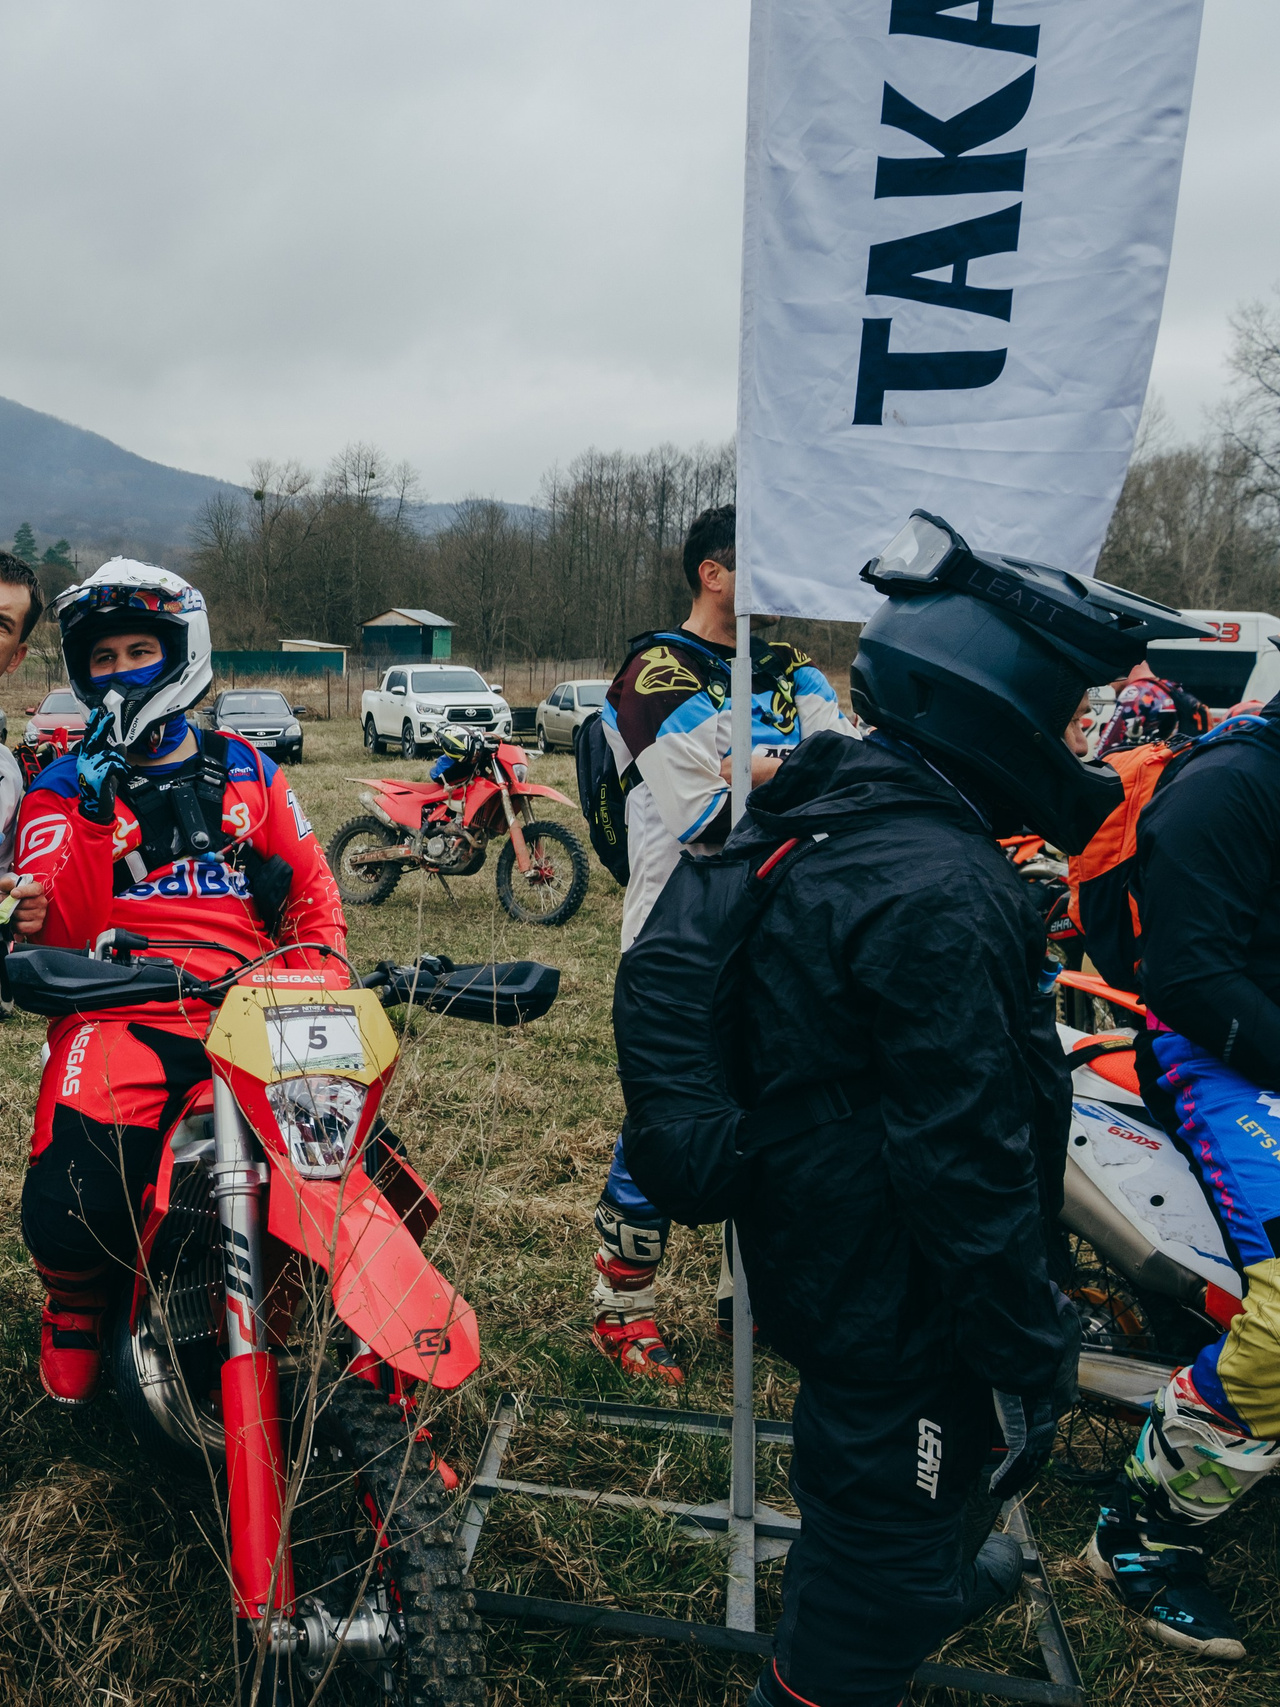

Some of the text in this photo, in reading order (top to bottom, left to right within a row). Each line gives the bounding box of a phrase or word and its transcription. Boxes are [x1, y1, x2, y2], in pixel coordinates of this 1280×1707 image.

[968, 569, 1063, 622] LEATT
[129, 717, 140, 741] AIROH
[252, 974, 326, 984] GASGAS
[308, 1025, 328, 1050] 5
[61, 1023, 95, 1097] ASGAS
[1107, 1125, 1163, 1151] 6DAYS
[1235, 1114, 1277, 1149] LET'S
[916, 1417, 942, 1499] LEATT
